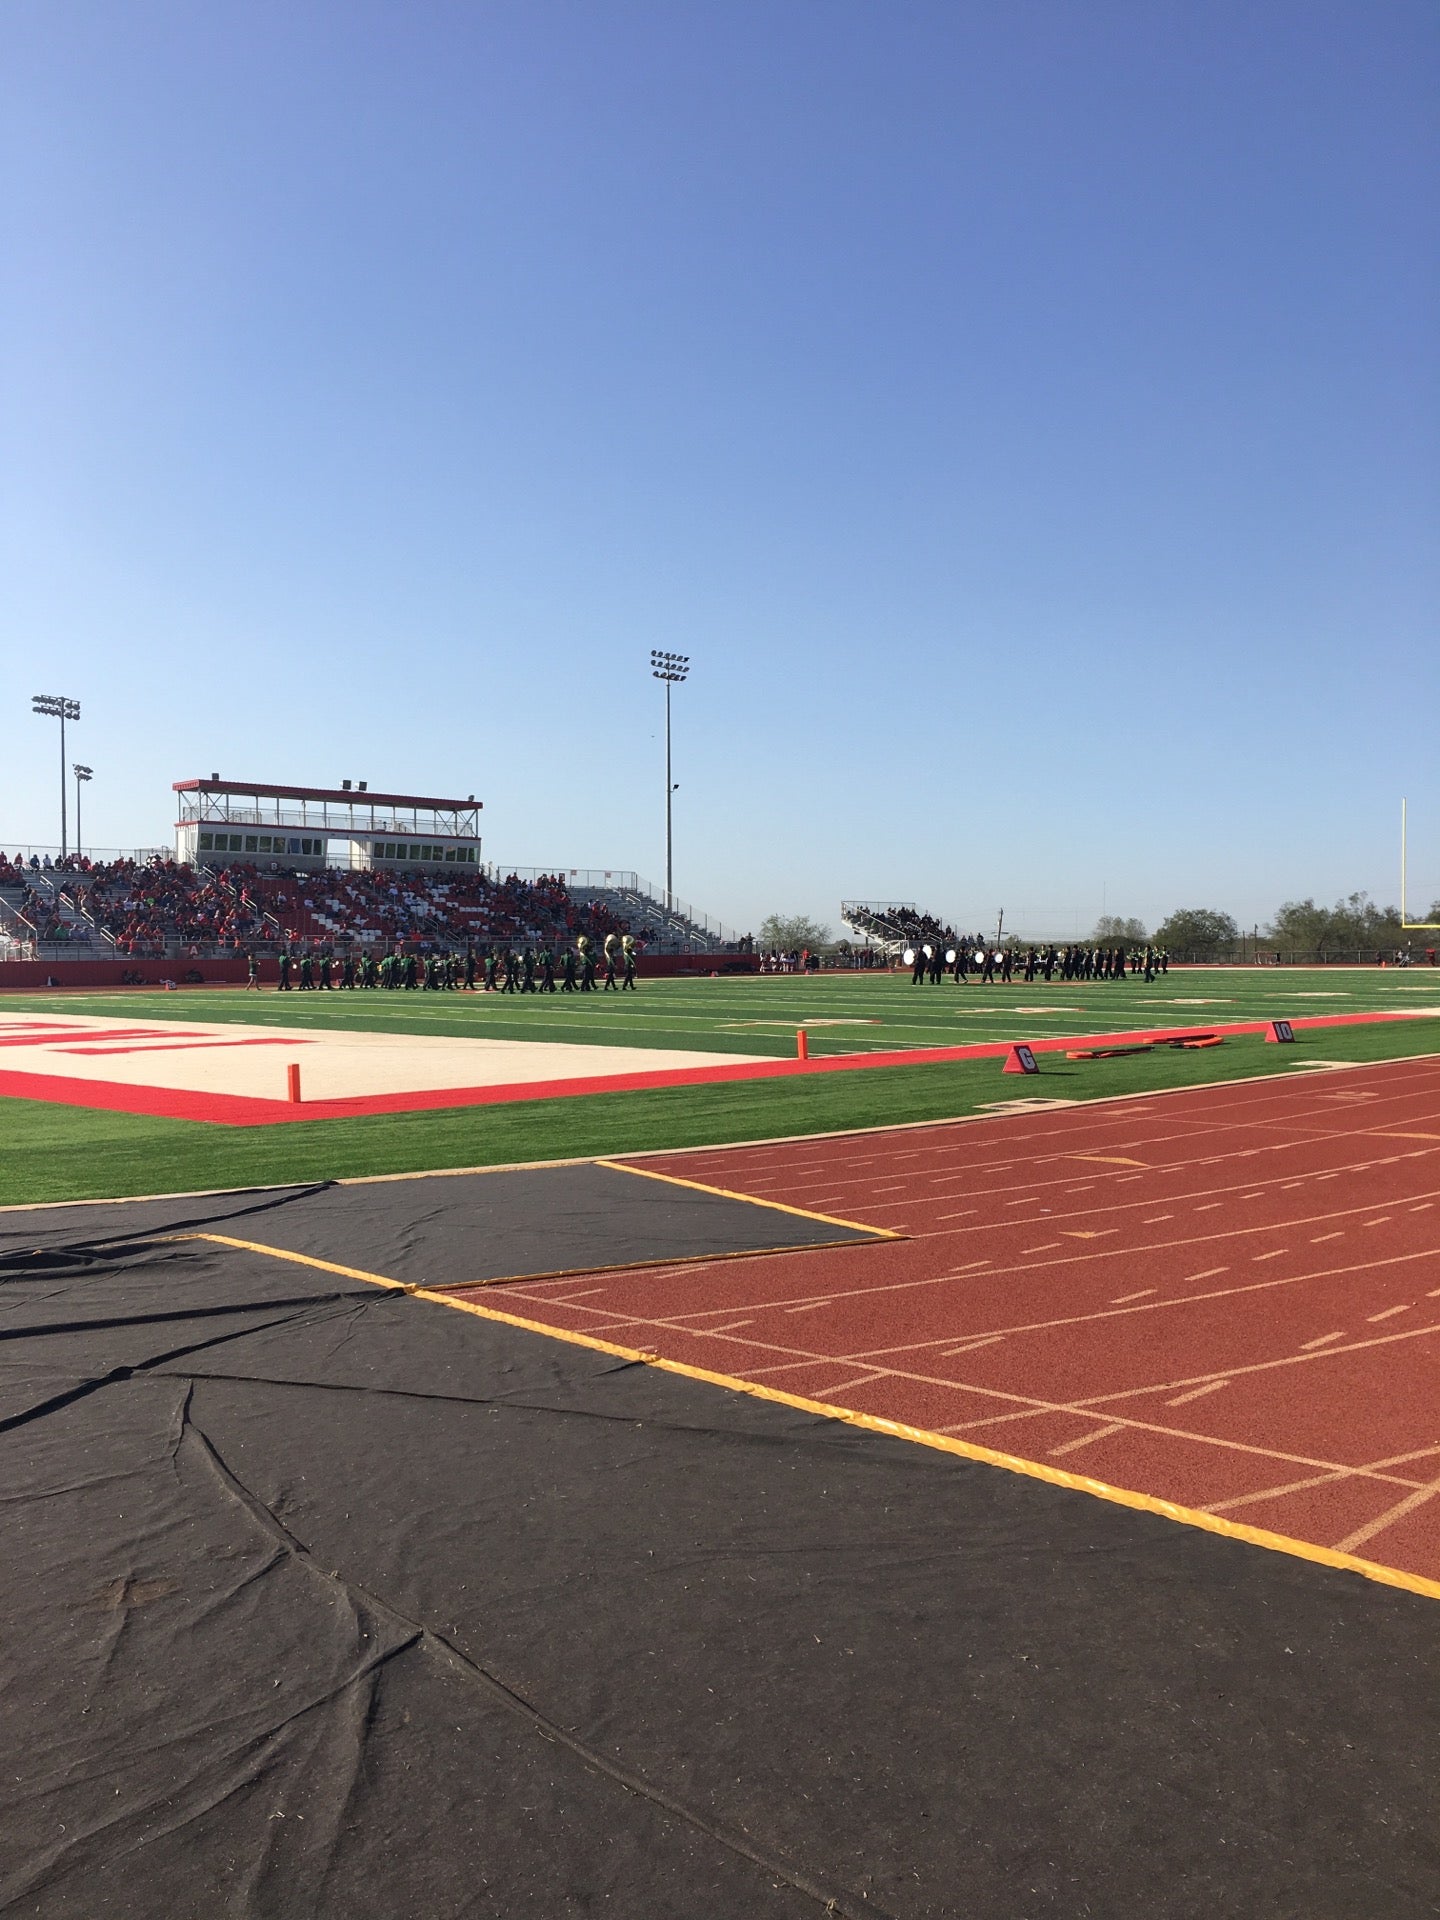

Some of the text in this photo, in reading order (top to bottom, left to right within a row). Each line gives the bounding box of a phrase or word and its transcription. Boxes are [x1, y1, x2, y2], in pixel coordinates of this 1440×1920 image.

[271, 862, 278, 870] B
[189, 946, 198, 955] A
[1274, 1023, 1292, 1040] 10
[1018, 1048, 1036, 1070] G
